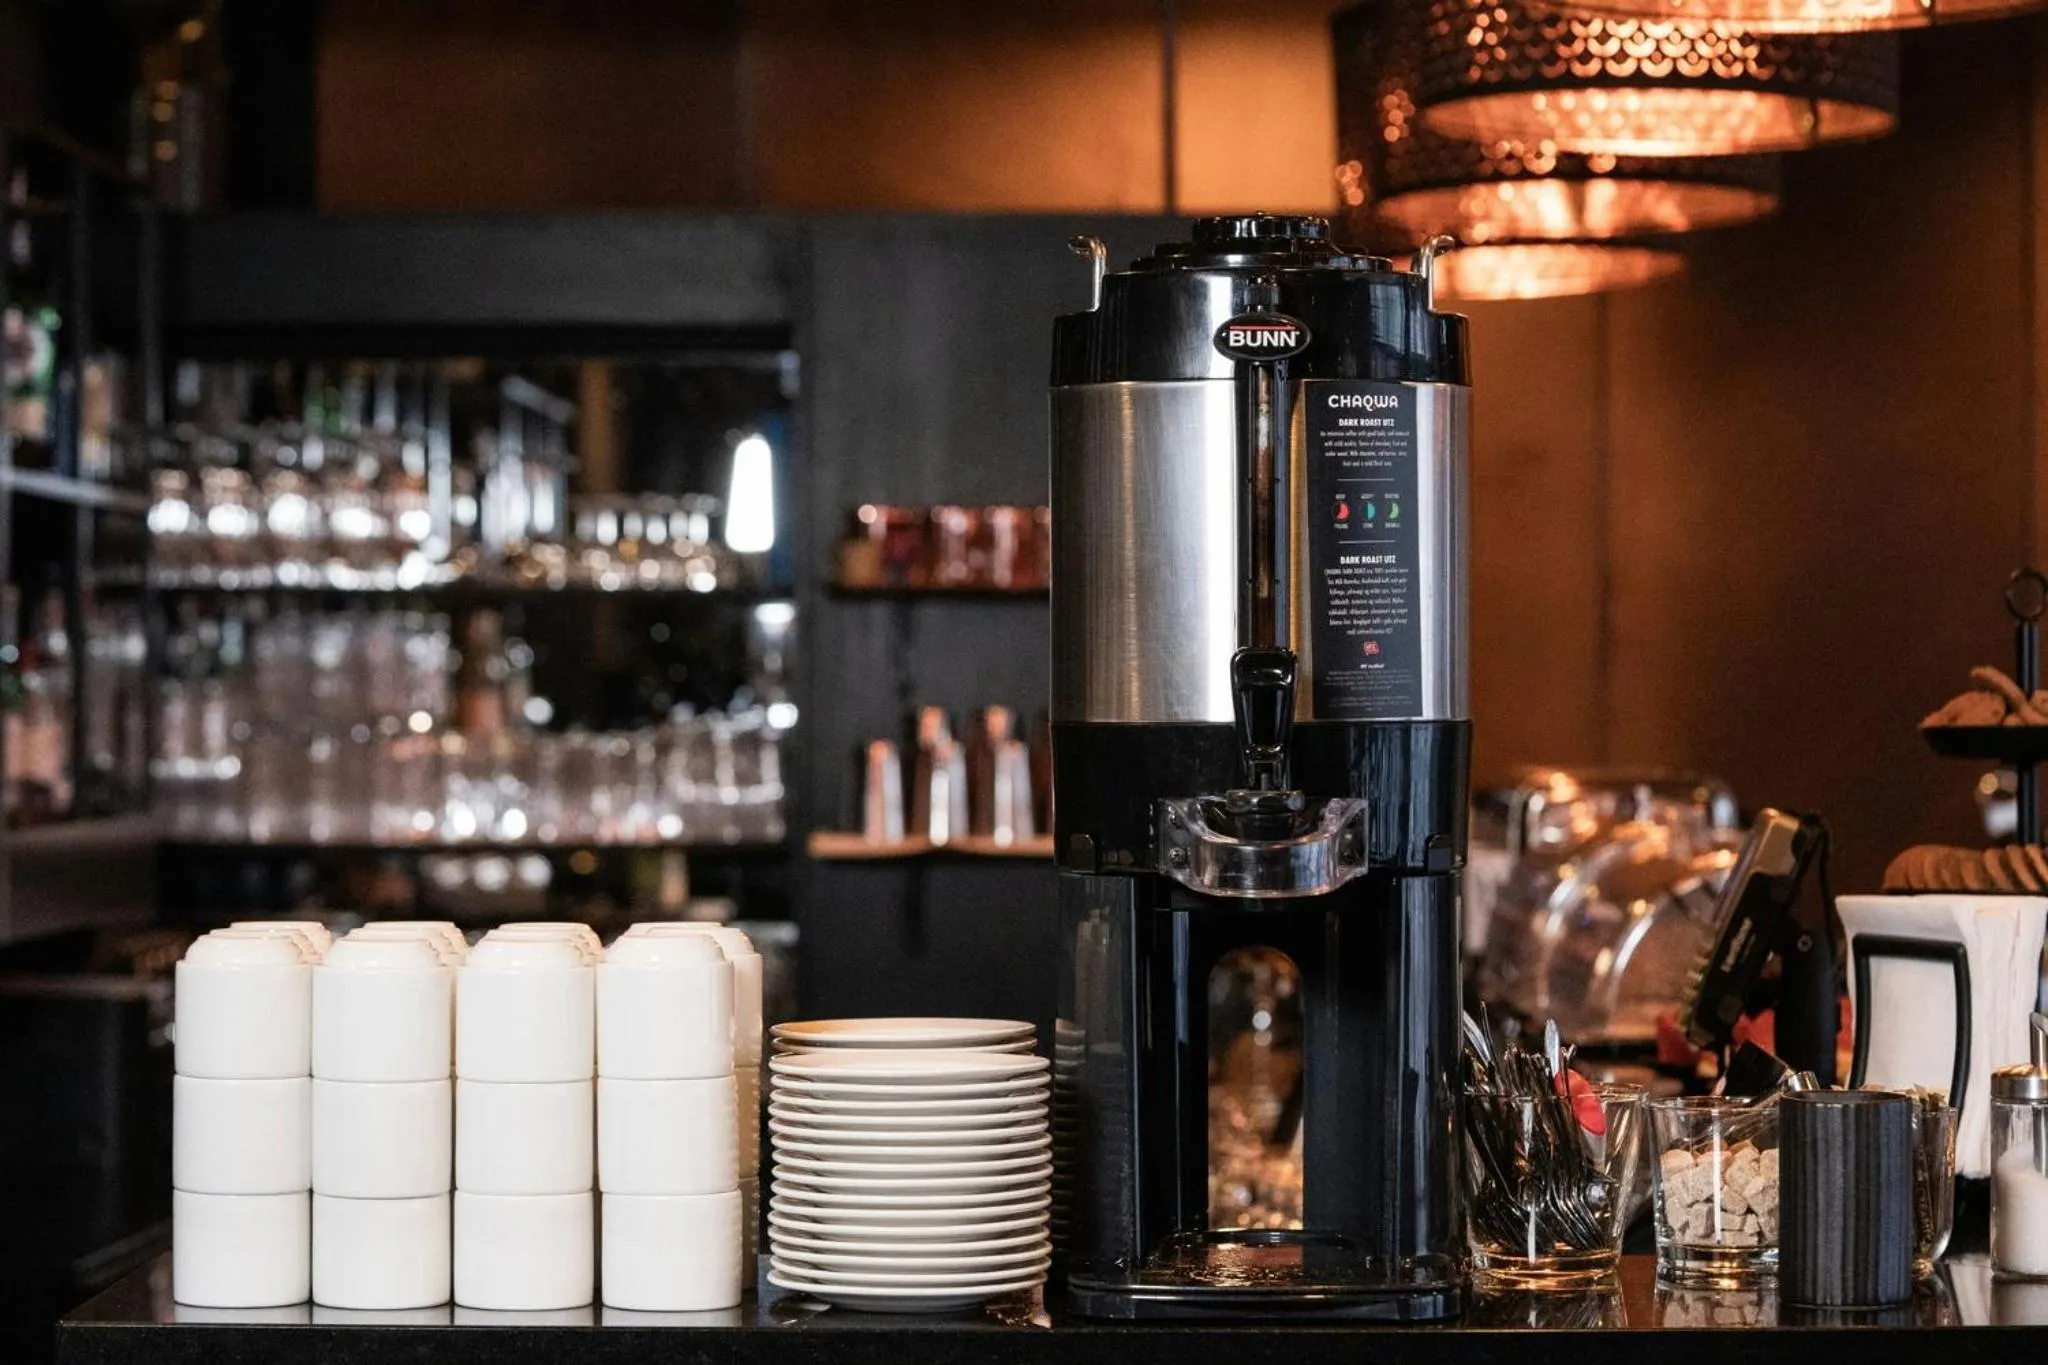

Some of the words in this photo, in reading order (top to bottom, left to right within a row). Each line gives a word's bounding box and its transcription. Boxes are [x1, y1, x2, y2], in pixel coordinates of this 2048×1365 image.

[1229, 330, 1296, 347] BUNN
[1327, 394, 1398, 411] CHAQWA
[1339, 418, 1358, 427] DARK
[1360, 418, 1381, 427] ROAST
[1340, 556, 1360, 565] DARK
[1361, 555, 1383, 564] ROAST
